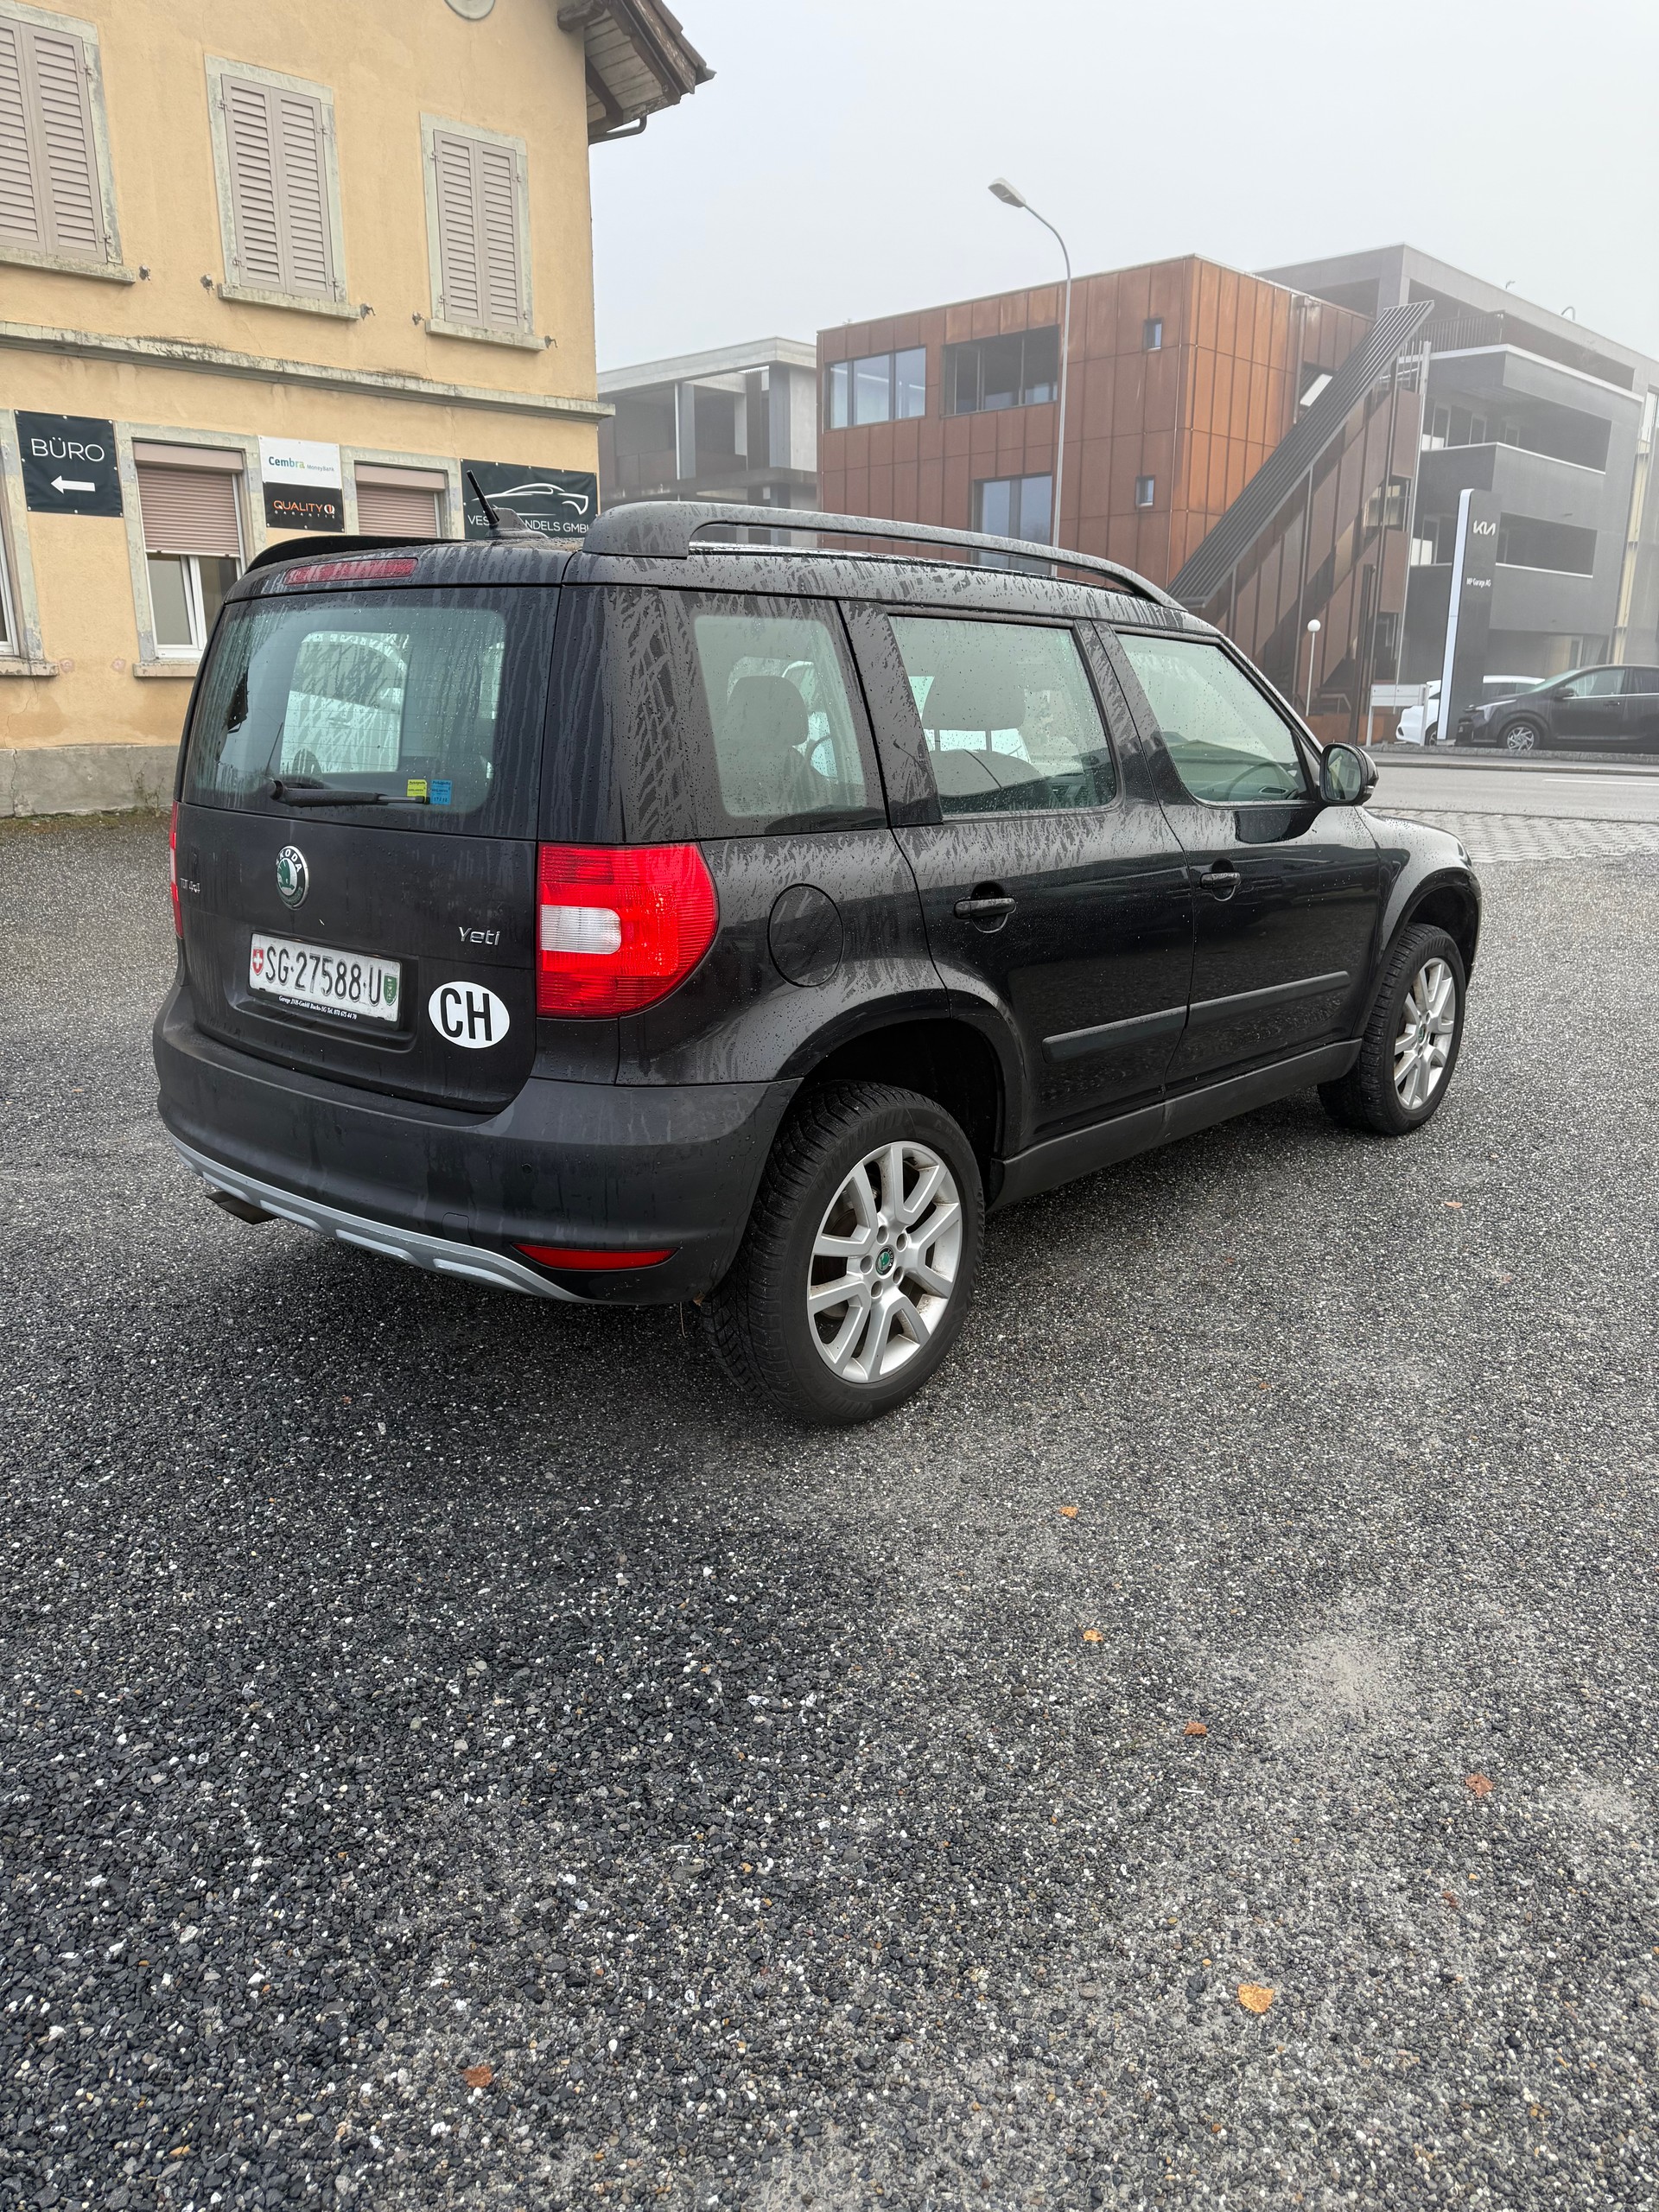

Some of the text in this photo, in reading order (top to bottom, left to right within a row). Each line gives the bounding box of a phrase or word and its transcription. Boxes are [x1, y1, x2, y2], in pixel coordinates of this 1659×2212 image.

[30, 436, 105, 462] BÜRO
[269, 455, 335, 473] Cembra MoneyBank
[273, 499, 323, 512] QUALITY
[563, 522, 589, 533] GMB
[1472, 520, 1496, 536] KIA
[1472, 578, 1484, 588] Garage
[458, 926, 501, 946] Yeti
[278, 995, 291, 1004] Garage
[440, 987, 493, 1042] CH
